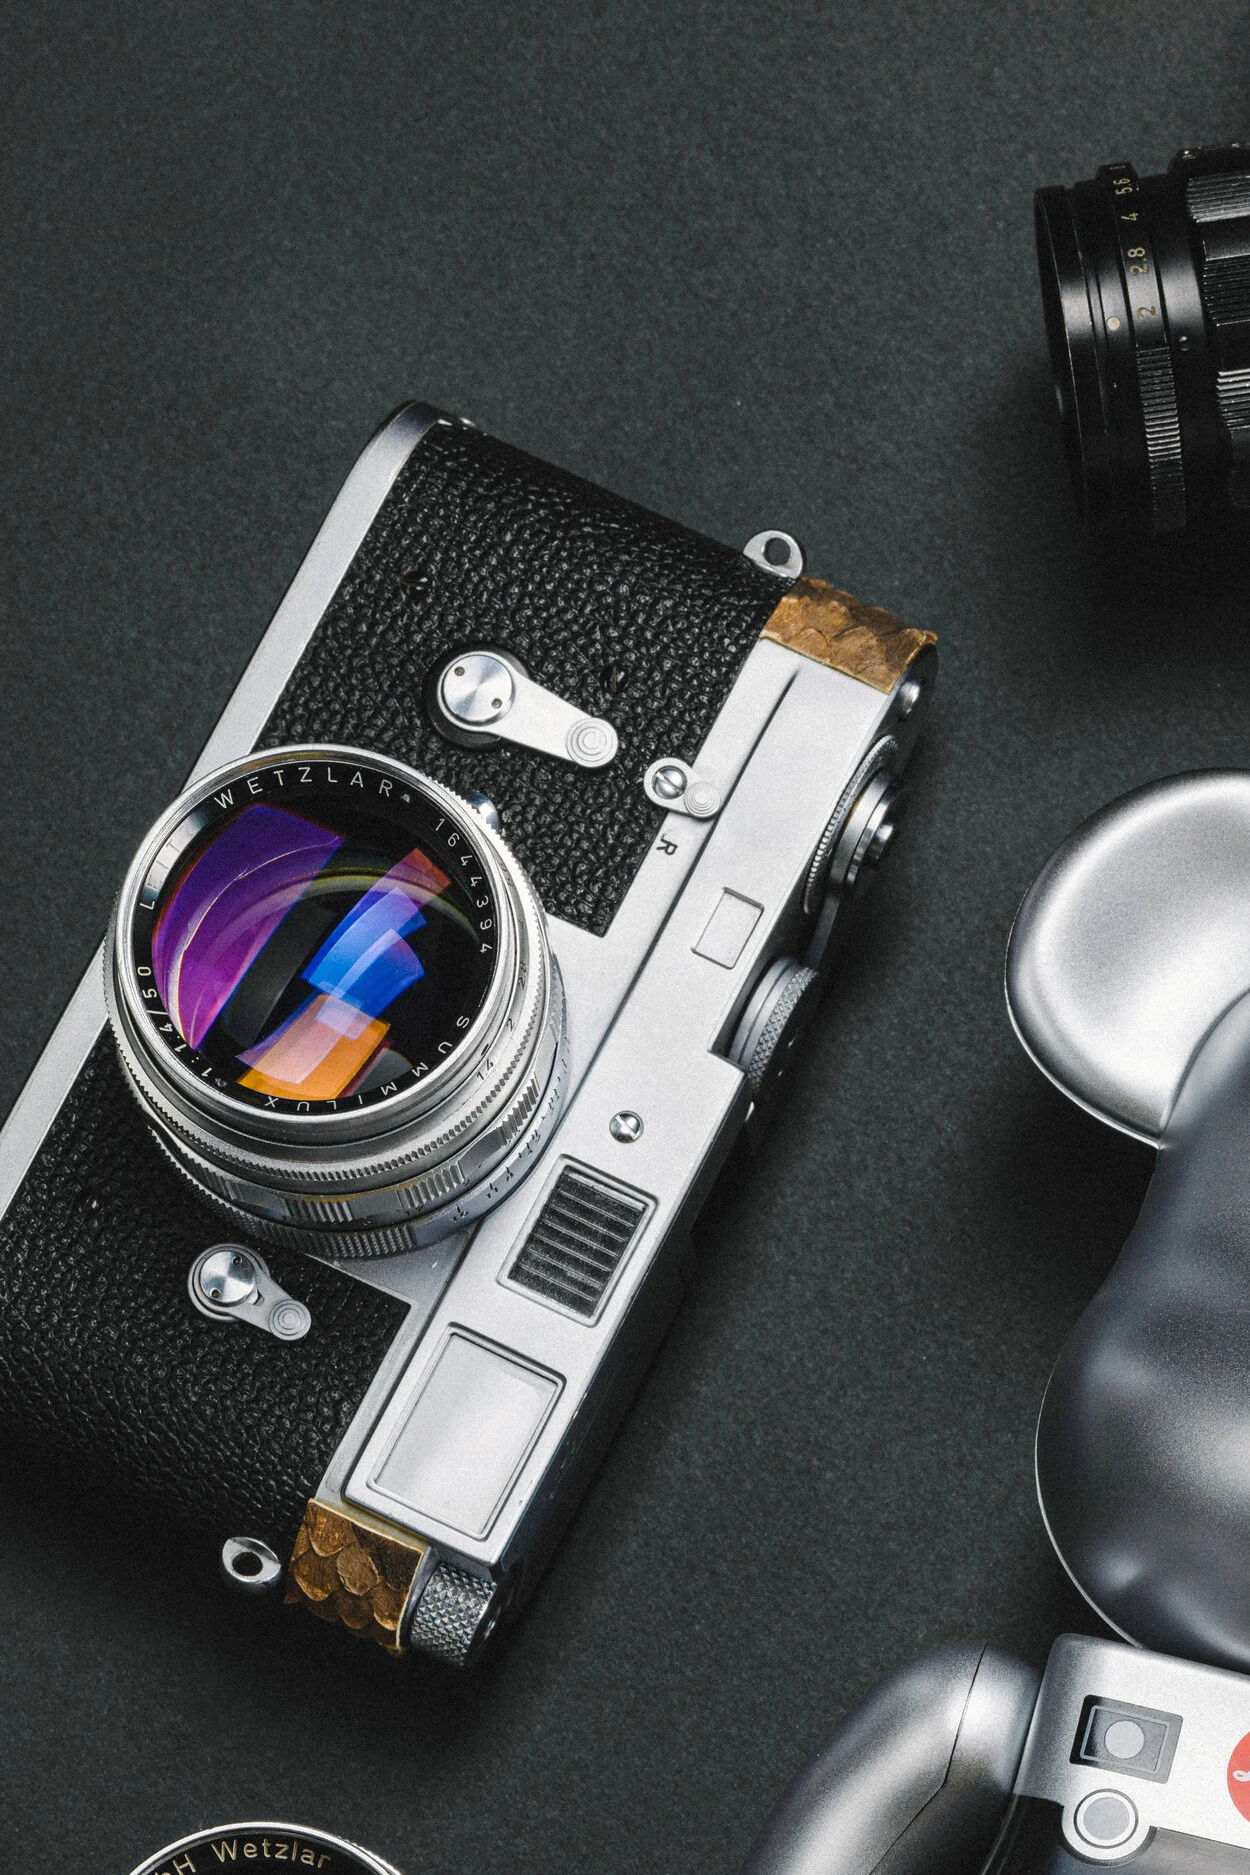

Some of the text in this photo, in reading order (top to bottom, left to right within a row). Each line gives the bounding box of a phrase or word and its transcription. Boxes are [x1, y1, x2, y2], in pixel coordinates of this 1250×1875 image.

[1112, 177, 1158, 319] 5.6 4 2.8 2
[139, 766, 395, 912] LEIT WETZLAR
[433, 816, 495, 956] 1644394
[264, 1013, 472, 1113] SUMMILUX
[476, 1058, 495, 1081] 1.4
[210, 1836, 333, 1870] Wetzlar
